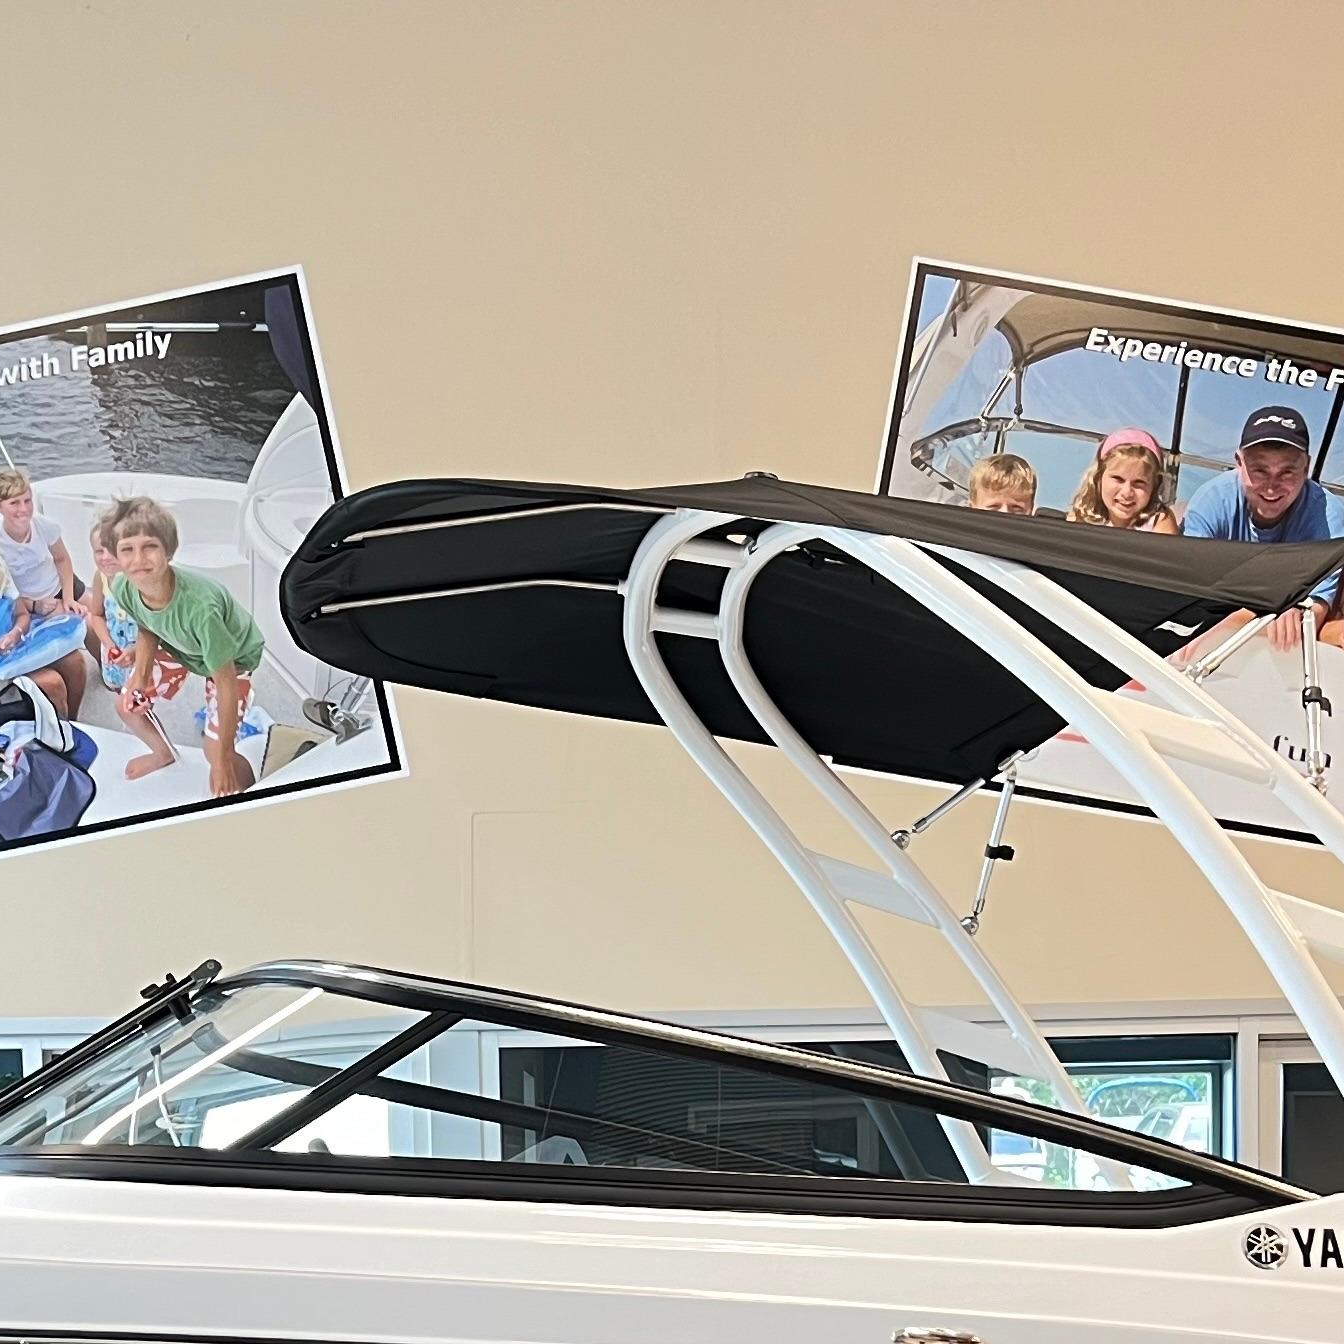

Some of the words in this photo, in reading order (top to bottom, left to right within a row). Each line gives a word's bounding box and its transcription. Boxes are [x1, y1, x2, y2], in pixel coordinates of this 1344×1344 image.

[71, 331, 172, 372] Family
[1084, 327, 1257, 378] Experience
[1266, 358, 1318, 388] the
